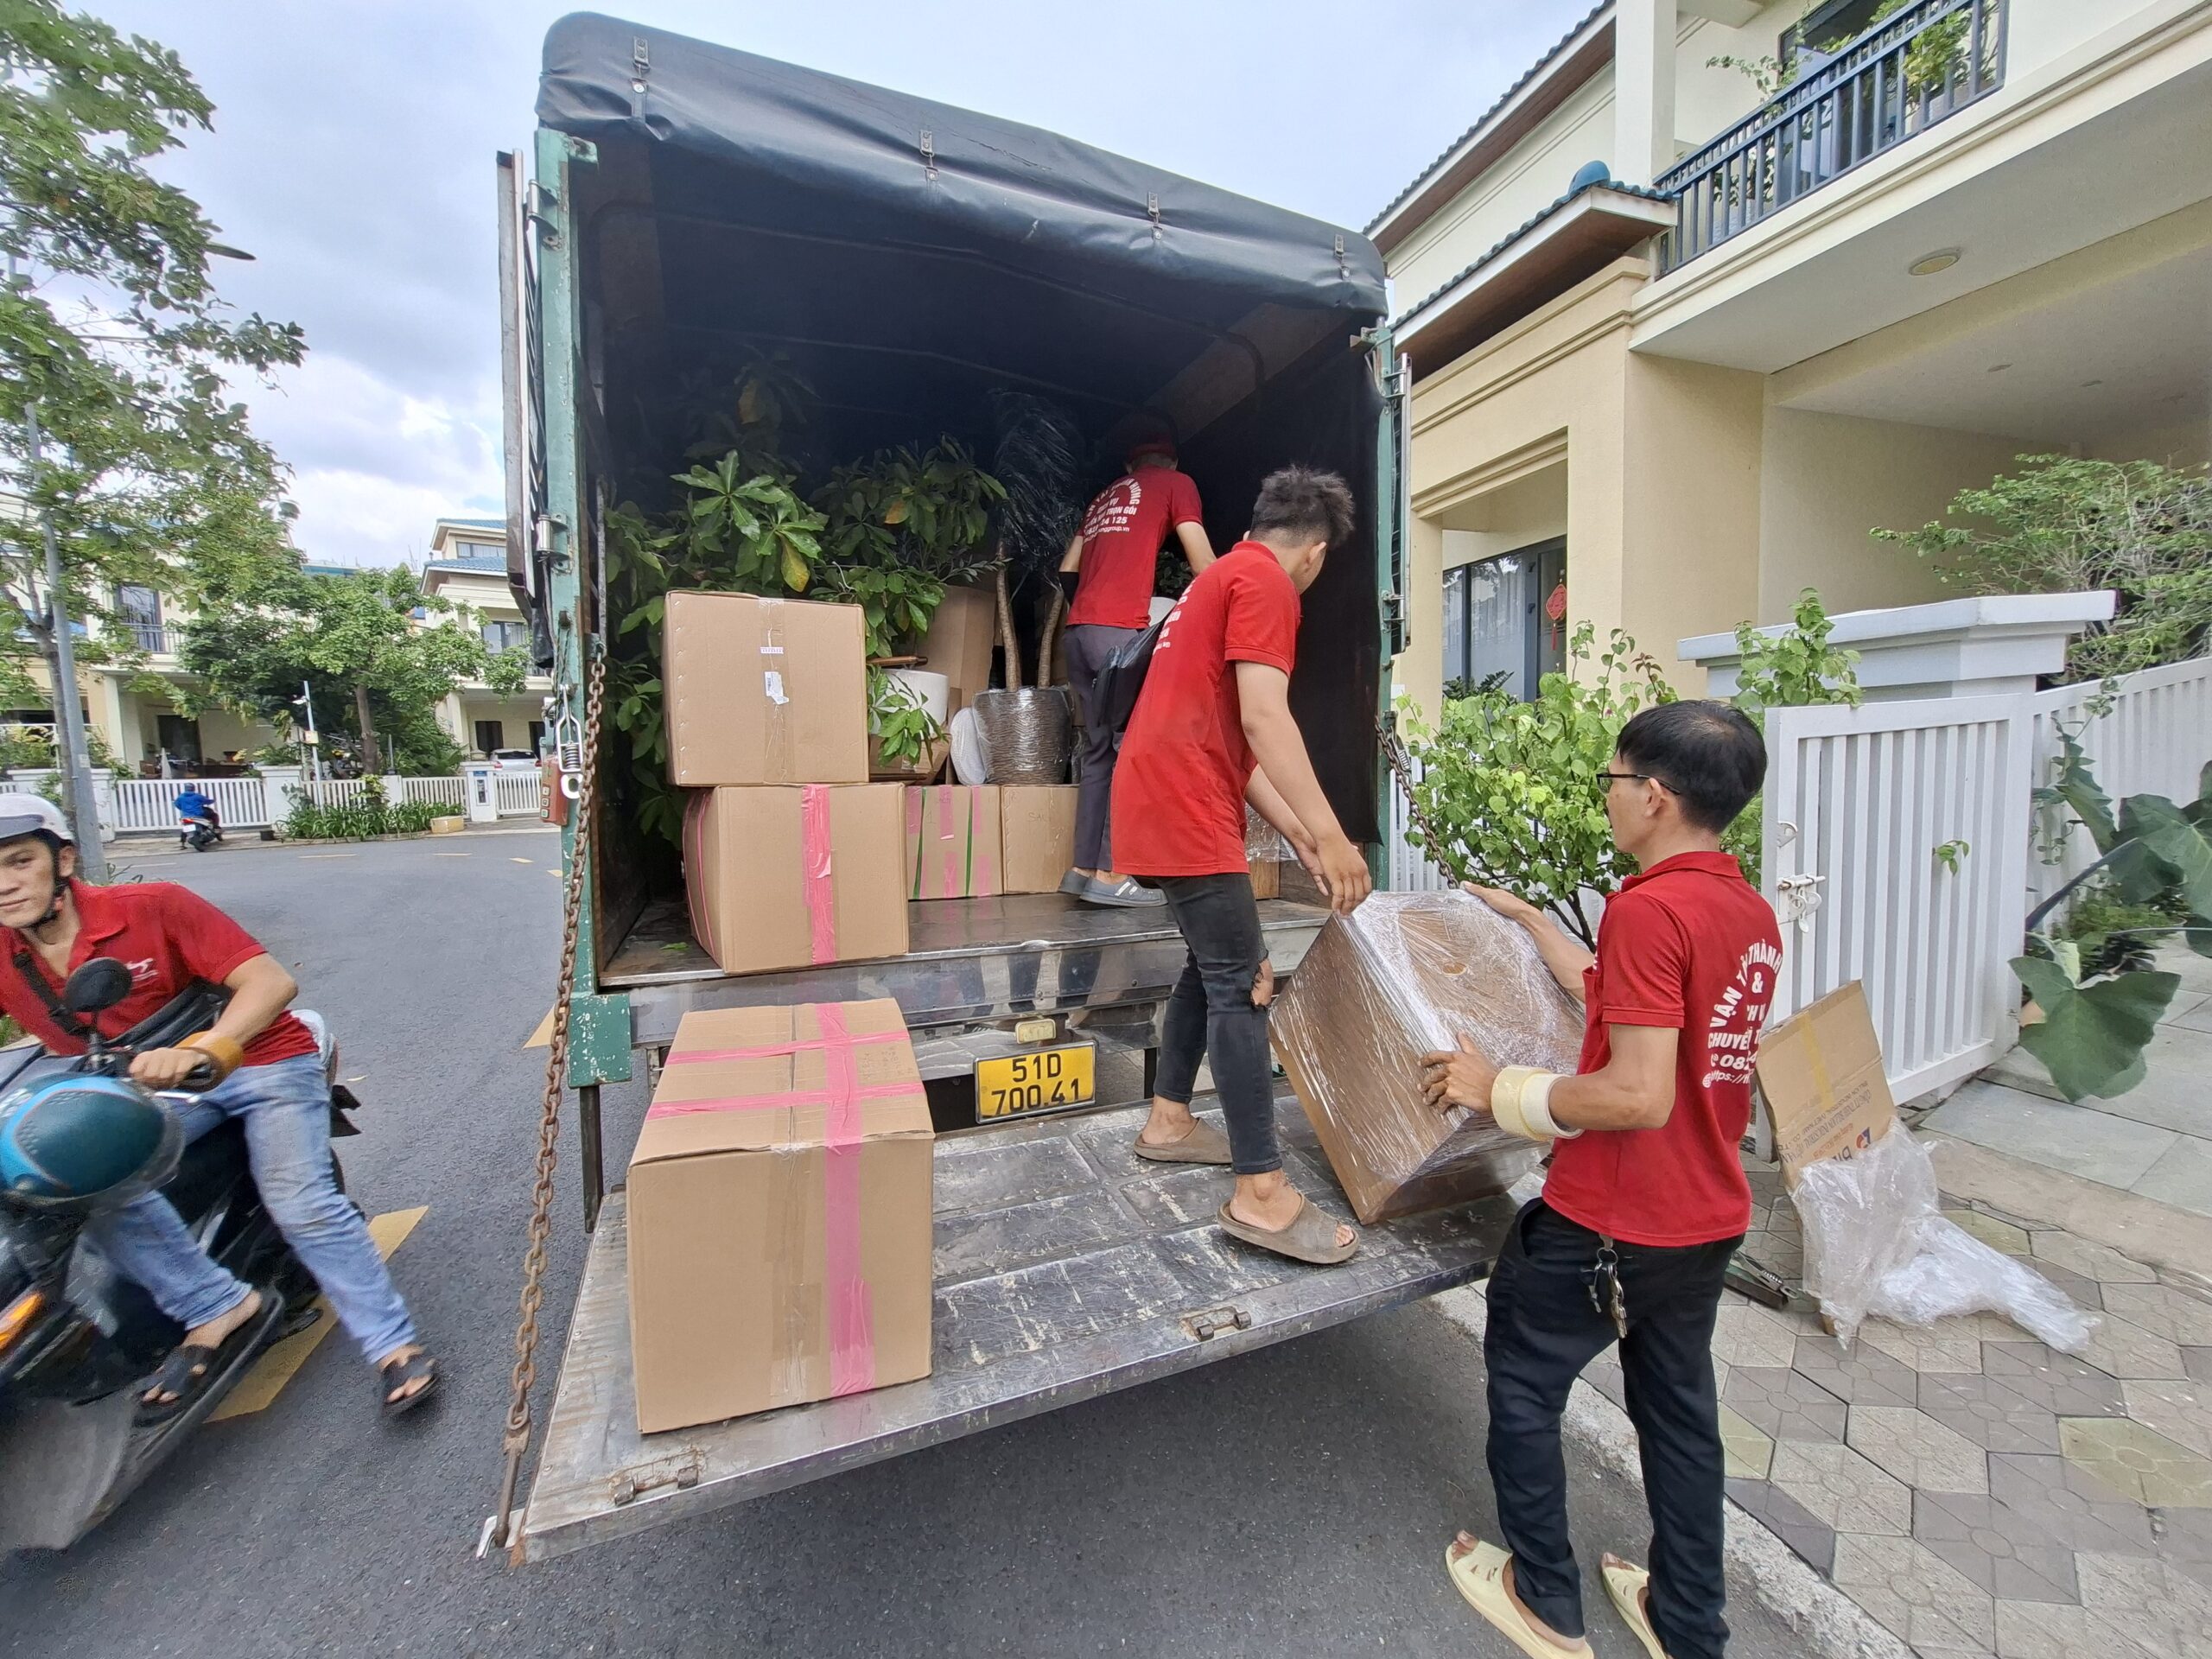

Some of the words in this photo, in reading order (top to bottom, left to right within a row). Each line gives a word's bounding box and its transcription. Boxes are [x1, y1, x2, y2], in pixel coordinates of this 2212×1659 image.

[1709, 986, 1743, 1028] VẬN
[1748, 938, 1783, 975] THÀNH
[1751, 971, 1764, 993] &
[1012, 1053, 1062, 1083] 51D
[991, 1078, 1079, 1116] 700.41
